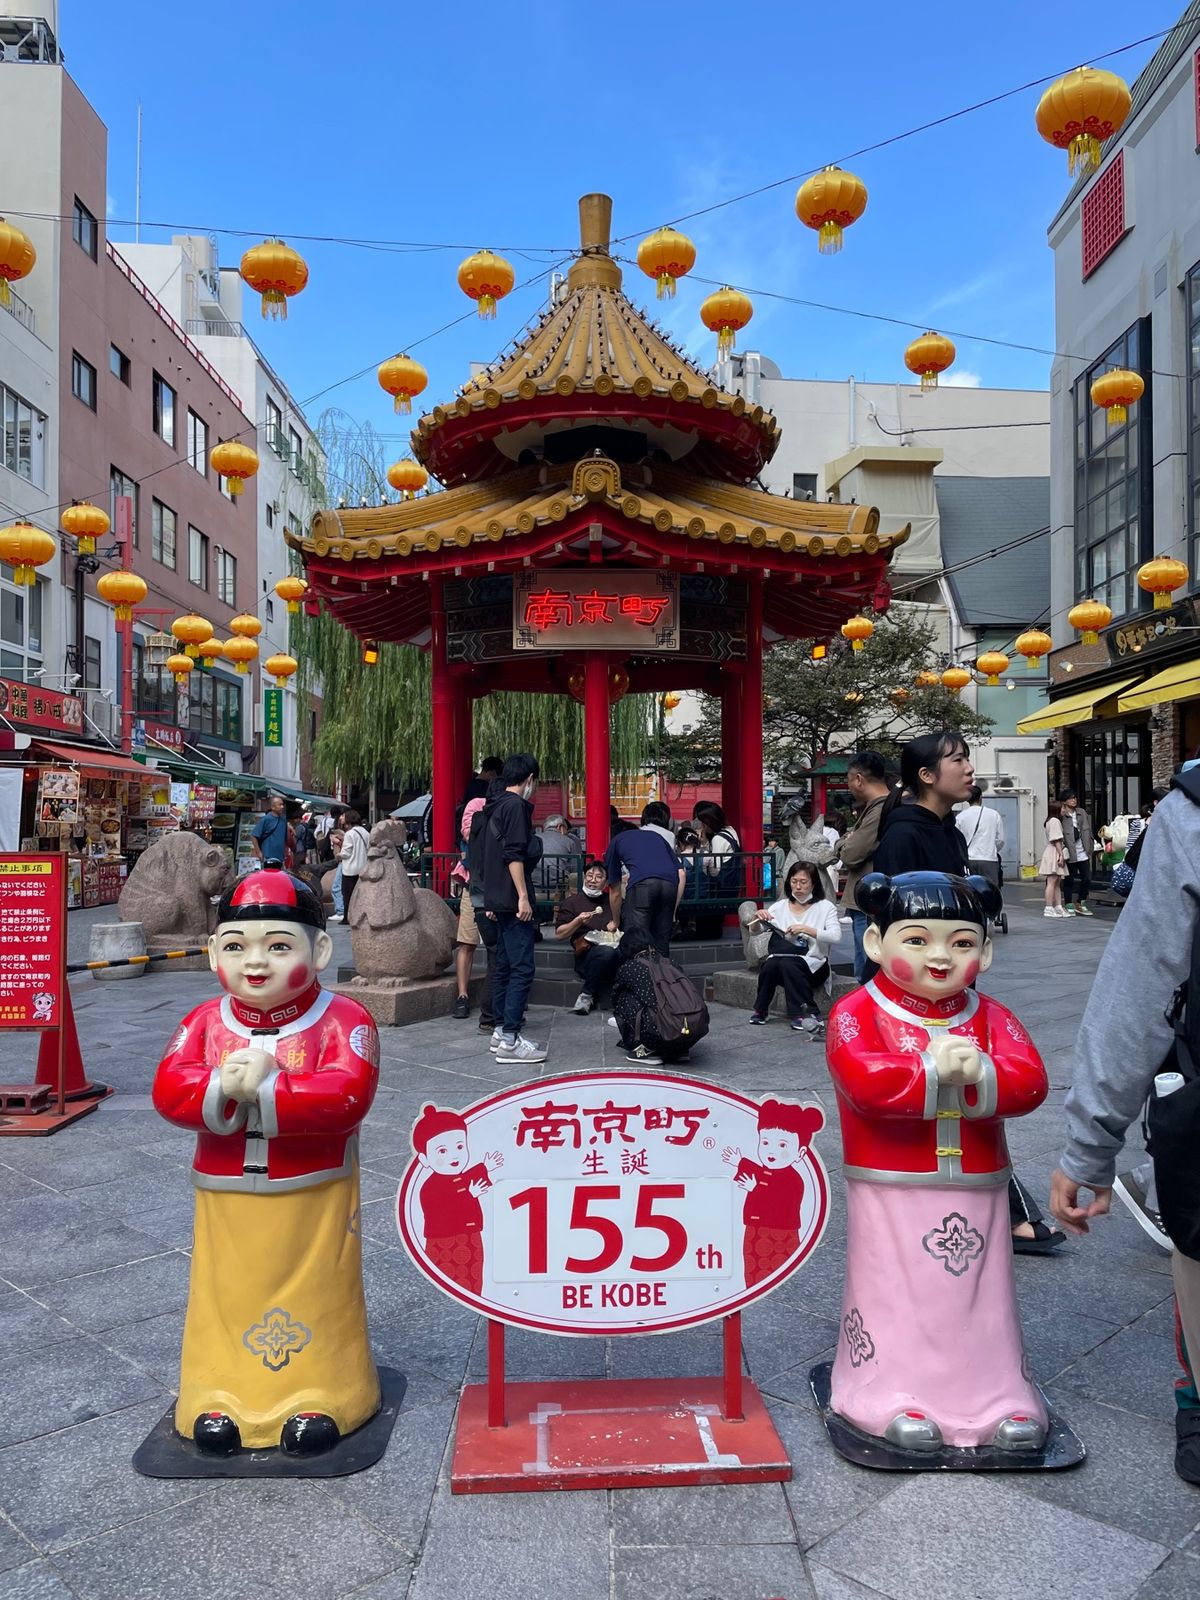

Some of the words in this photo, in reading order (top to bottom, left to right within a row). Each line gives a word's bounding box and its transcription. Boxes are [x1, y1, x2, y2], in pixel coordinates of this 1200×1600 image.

[523, 588, 670, 629] 南京町
[515, 1100, 709, 1152] 南京町
[581, 1148, 651, 1177] 生誕
[562, 1284, 593, 1309] BE
[601, 1282, 667, 1307] KOBE
